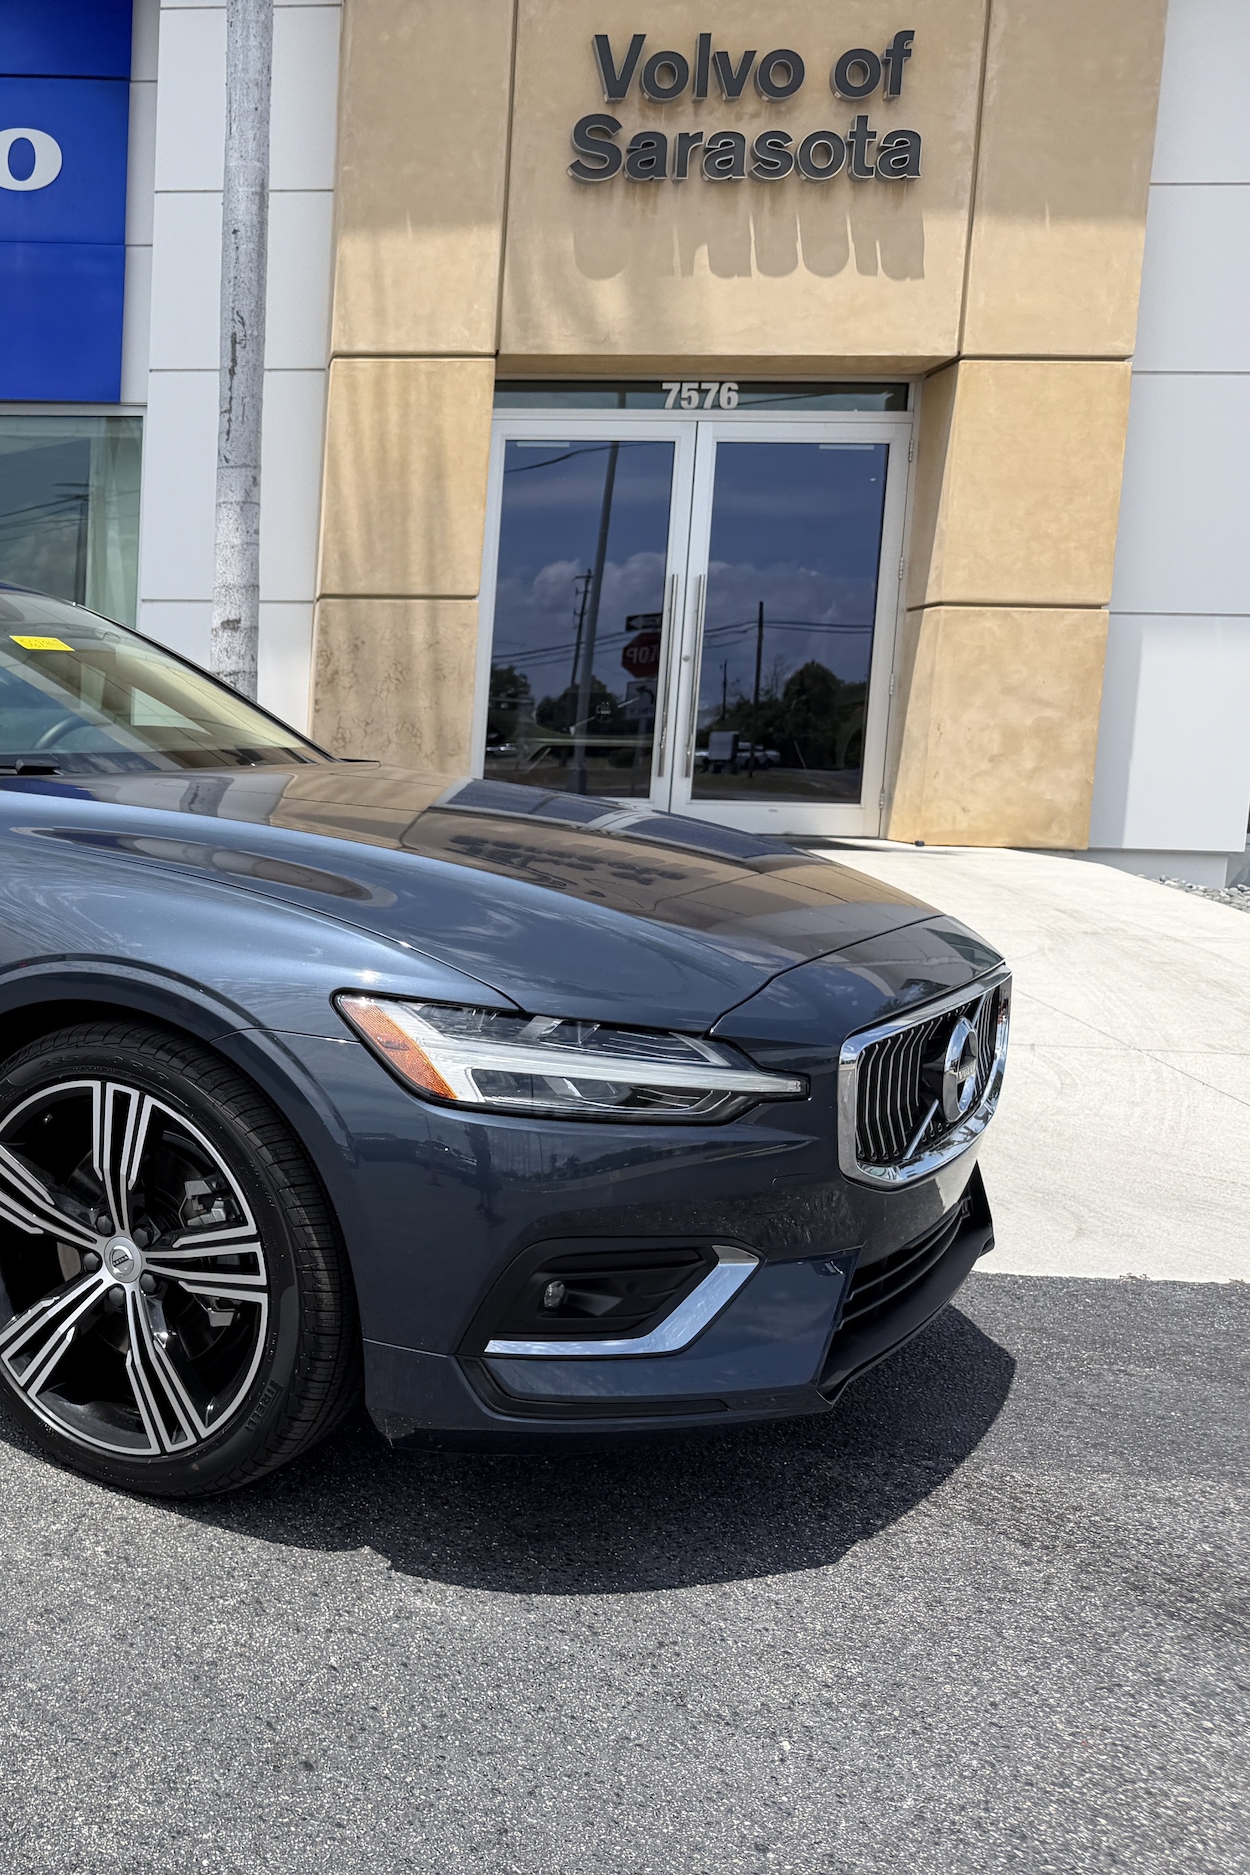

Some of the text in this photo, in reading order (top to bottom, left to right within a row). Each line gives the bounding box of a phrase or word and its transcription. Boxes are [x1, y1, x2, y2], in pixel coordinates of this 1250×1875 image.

[592, 30, 915, 102] Volvo of
[566, 113, 923, 183] Sarasota
[661, 382, 739, 410] 7576
